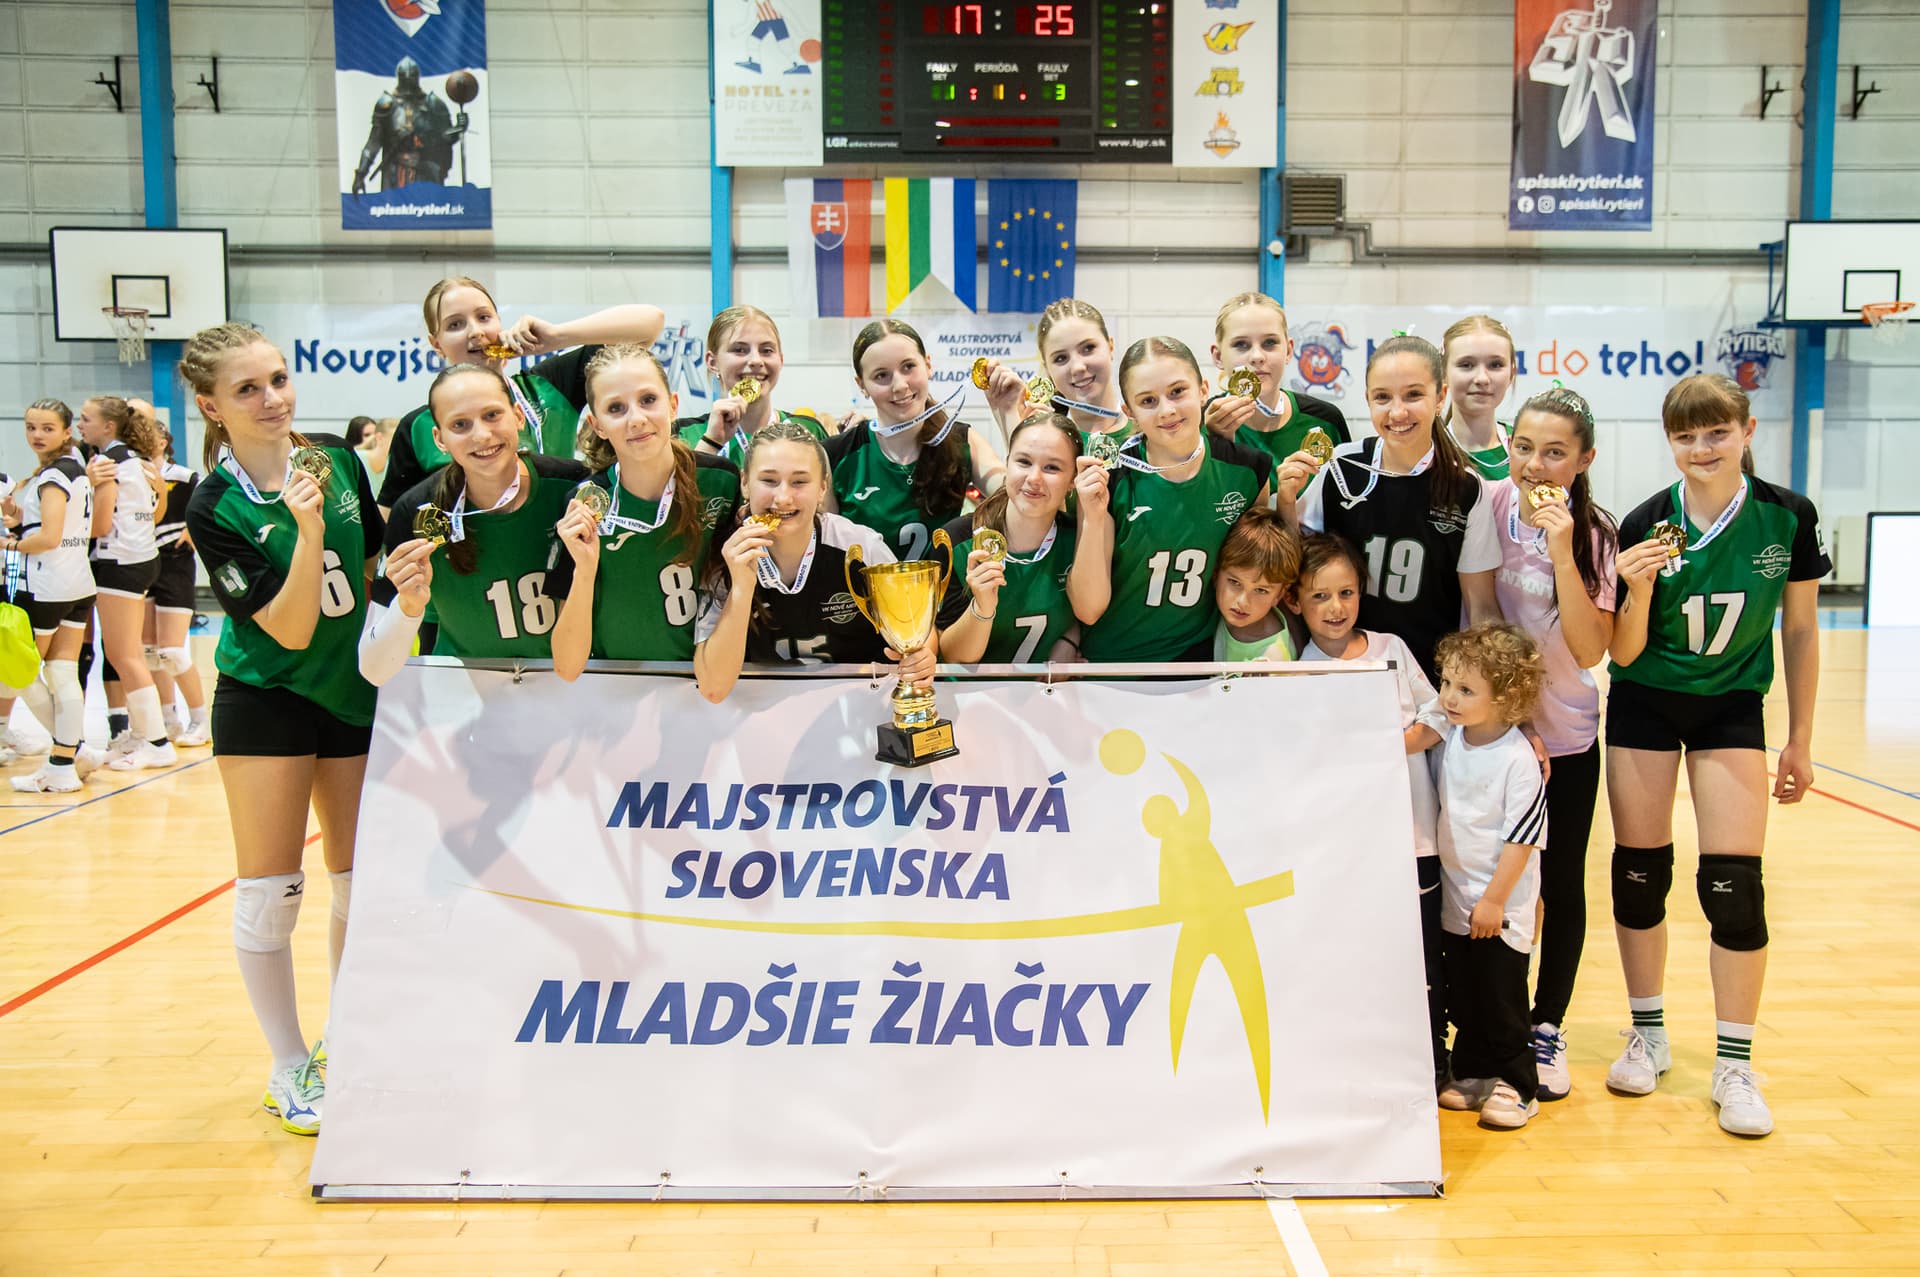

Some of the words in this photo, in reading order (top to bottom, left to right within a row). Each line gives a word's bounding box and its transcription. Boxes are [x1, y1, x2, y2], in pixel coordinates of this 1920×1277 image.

[955, 5, 982, 35] 17
[1035, 5, 1074, 35] 25
[926, 62, 958, 73] FAULY
[974, 62, 1019, 73] PERIÓDA
[1037, 62, 1069, 73] FAULY
[724, 86, 784, 97] HOTEL
[724, 100, 813, 112] PREVEZA
[1056, 84, 1066, 100] 3
[826, 137, 848, 148] LGR
[1099, 138, 1166, 148] www.lgr.sk
[1518, 173, 1644, 192] spisskirytieri.sk
[370, 203, 464, 217] spisskirytieri.sk
[938, 331, 1023, 343] MAJSTROVSTVÁ
[948, 347, 1011, 356] SLOVENSKA
[1538, 339, 1588, 376] do
[1599, 340, 1704, 378] teho!
[930, 368, 970, 381] MLAD
[899, 523, 928, 561] 2
[1145, 548, 1207, 608] 13
[1365, 536, 1424, 602] 19
[486, 571, 556, 639] 18
[660, 563, 698, 626] 8
[1681, 591, 1746, 656] 17
[1012, 614, 1048, 664] 7
[606, 771, 1071, 833] MAJSTROVSTVÁ
[665, 847, 1011, 901] SLOVENSKA
[515, 962, 861, 1046] MLADŠIE
[869, 960, 1151, 1047] ŽIAČKY
